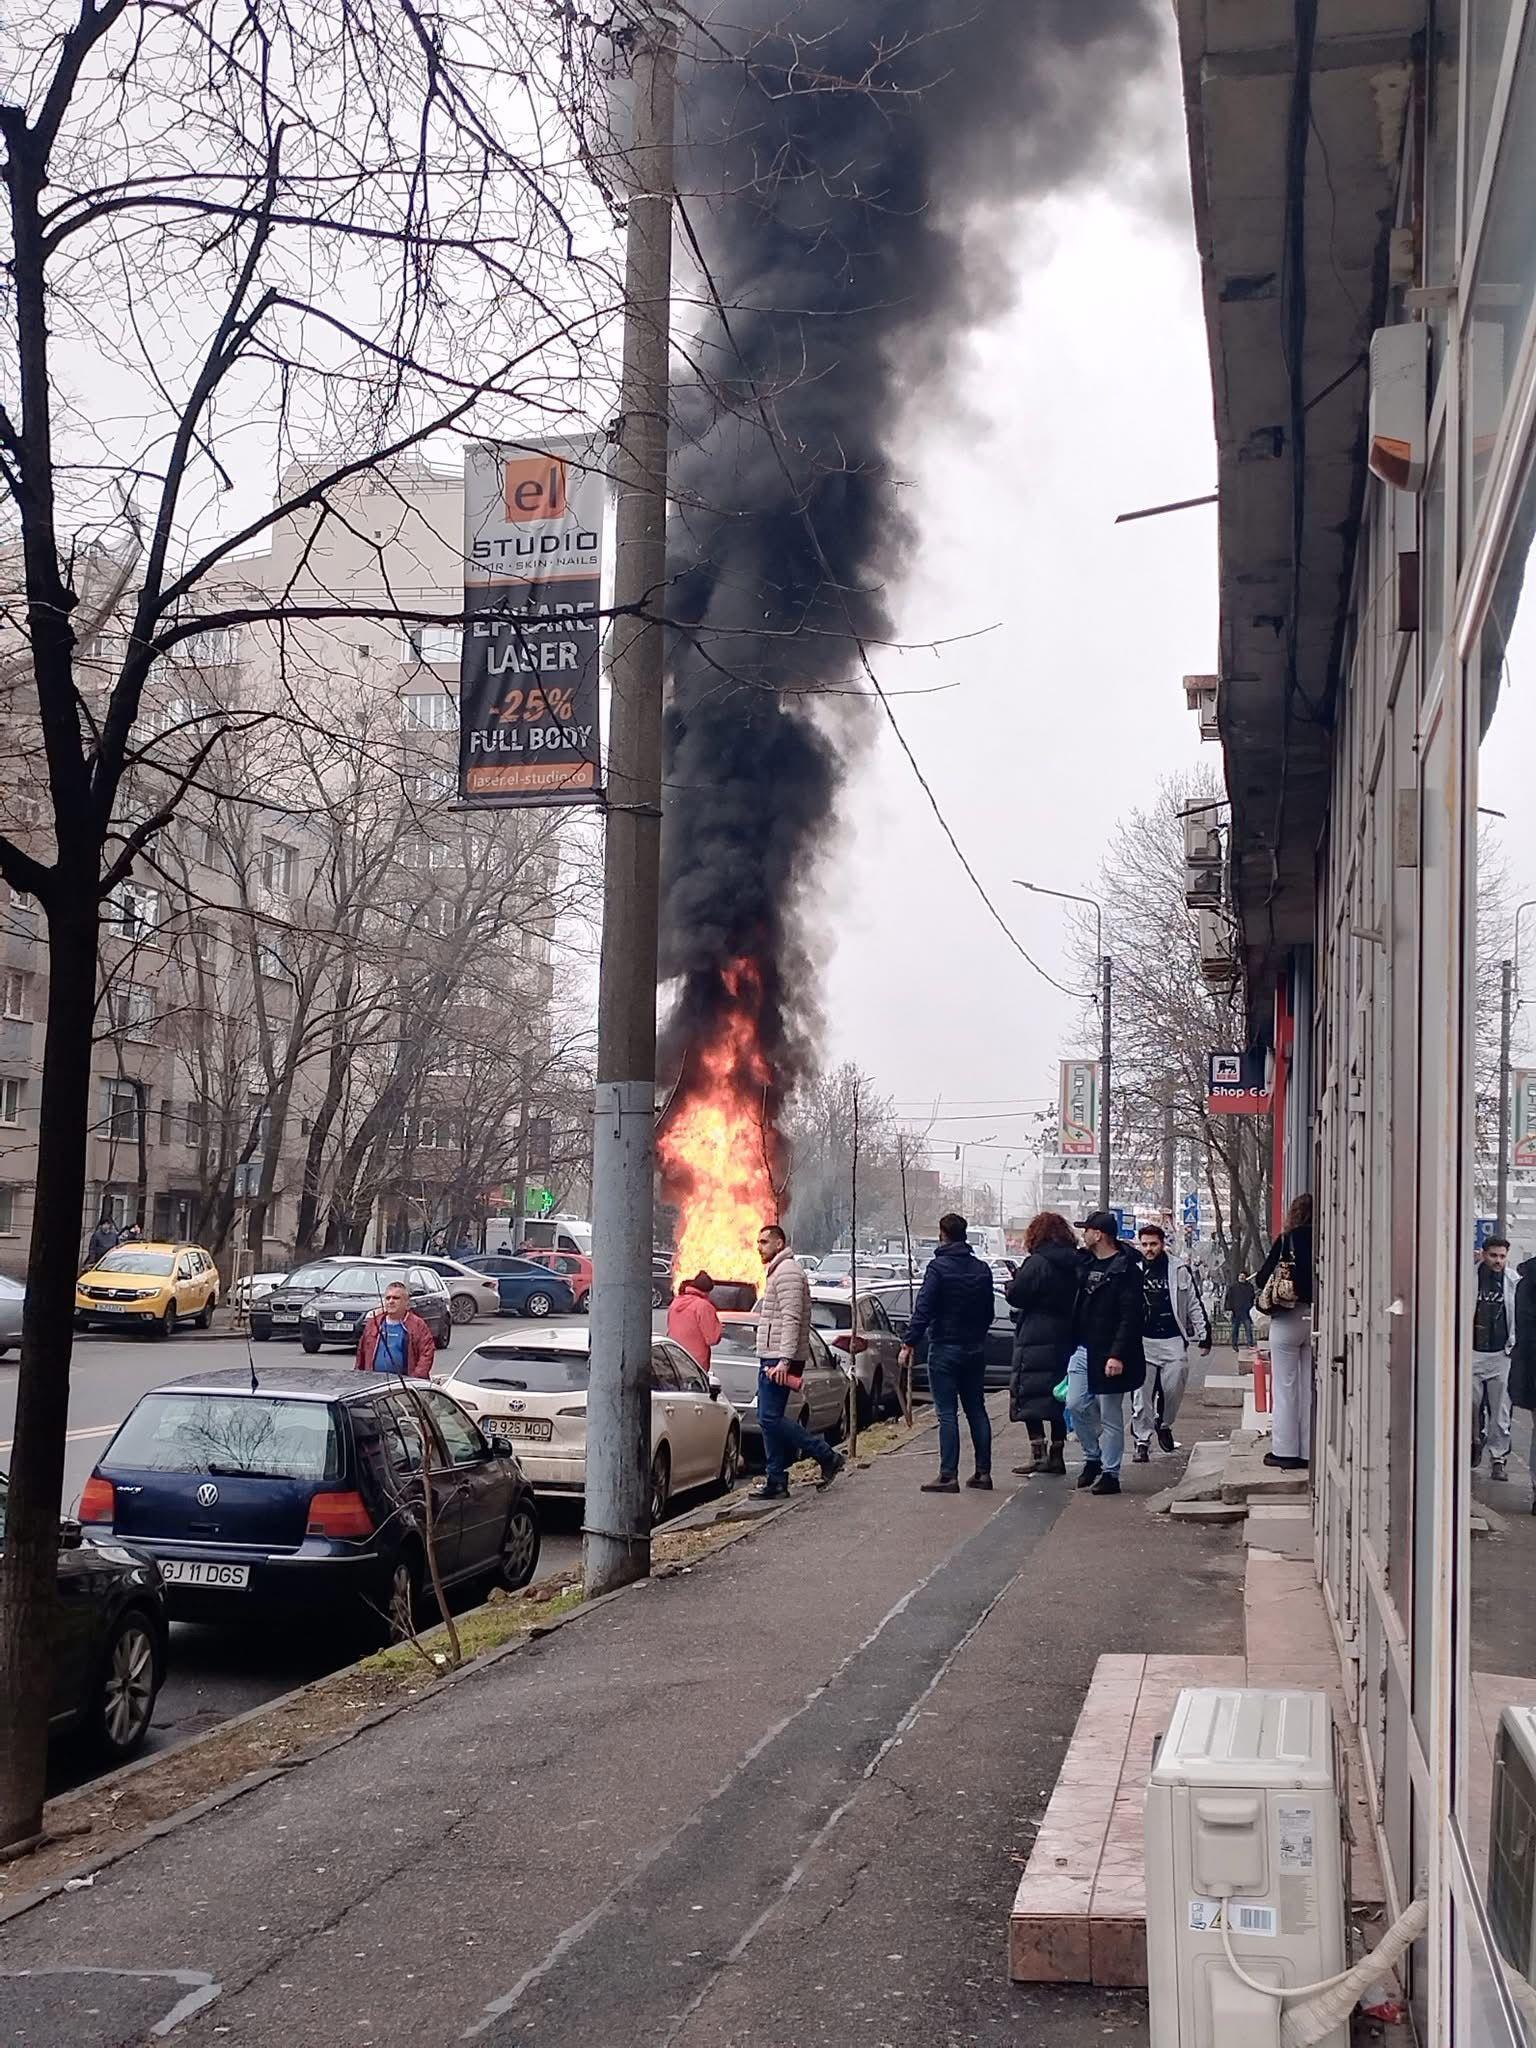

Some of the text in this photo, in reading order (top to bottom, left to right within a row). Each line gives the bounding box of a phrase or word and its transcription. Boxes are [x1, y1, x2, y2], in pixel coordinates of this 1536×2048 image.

[515, 466, 557, 512] el
[473, 532, 598, 558] STUDIO
[515, 560, 548, 571] SKIN
[556, 555, 598, 567] NAILS
[487, 641, 579, 675] LASER
[489, 687, 577, 723] -25%
[470, 725, 593, 754] FULL BODY
[1212, 1086, 1245, 1099] Shop
[489, 1421, 497, 1432] B
[524, 1422, 550, 1436] MOD
[162, 1562, 244, 1585] GJ 11 DGS
